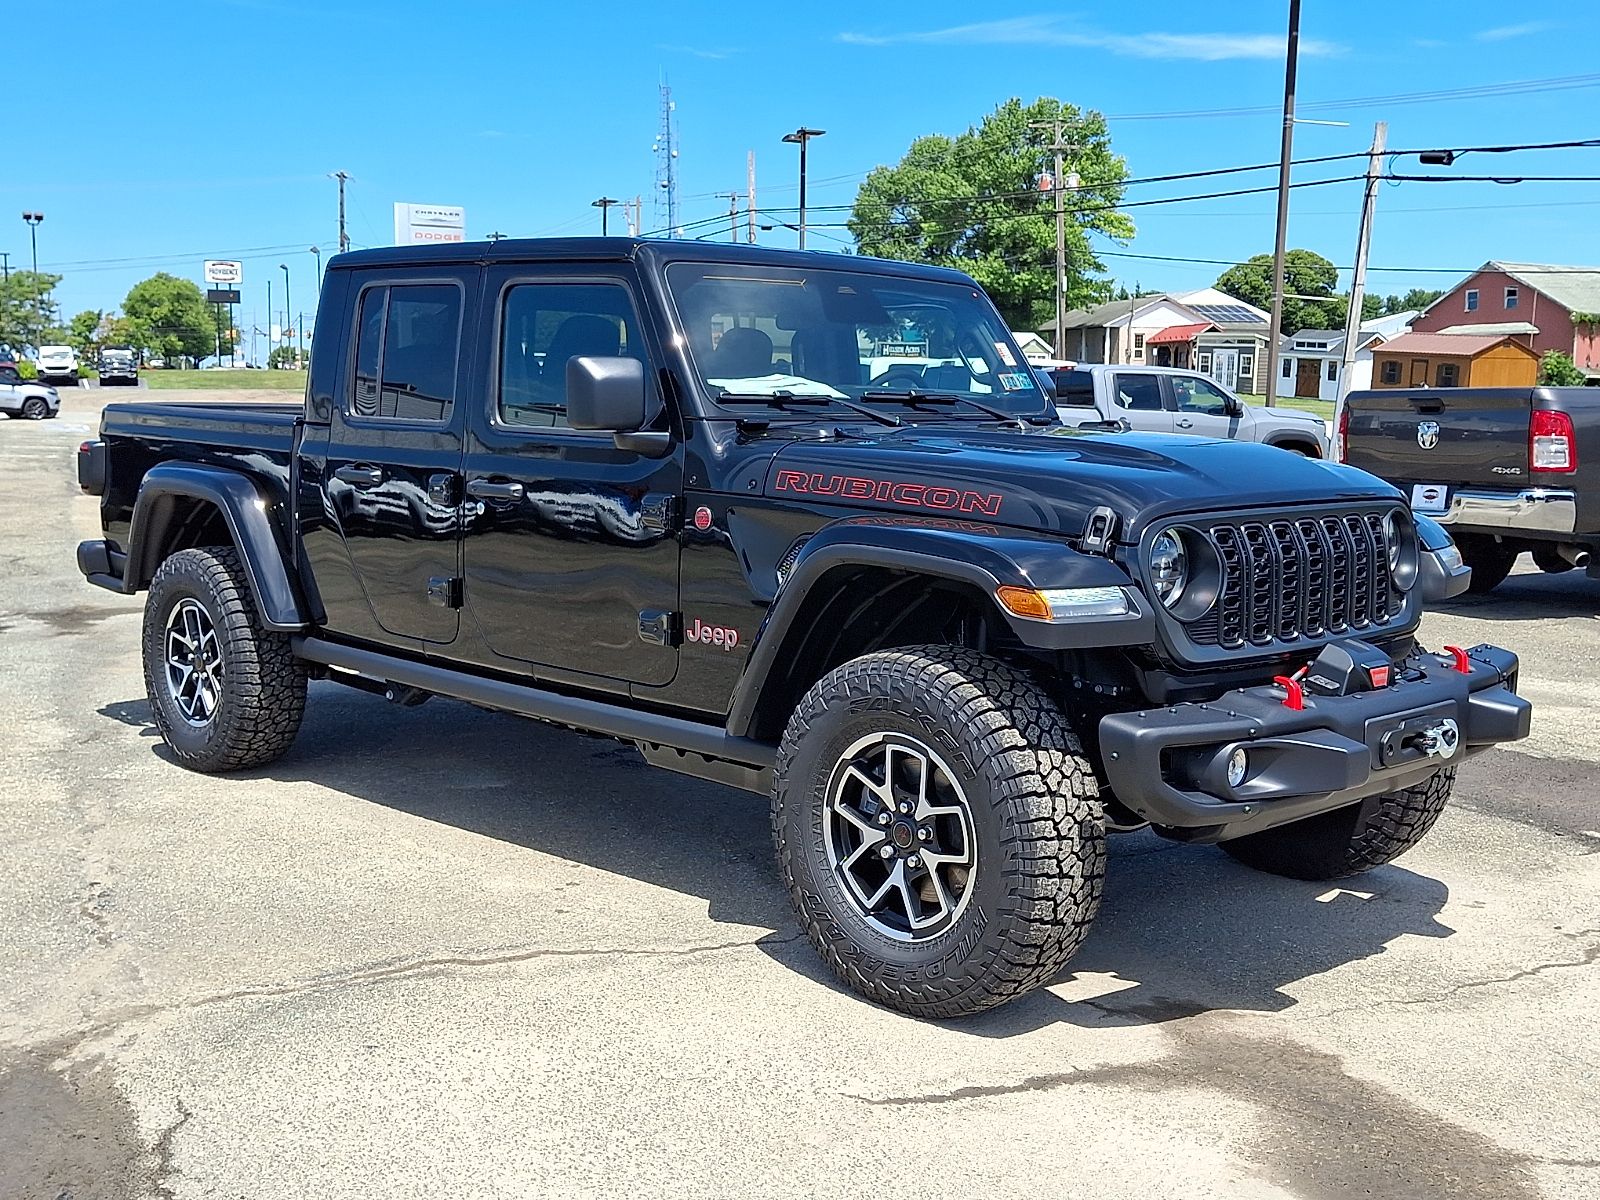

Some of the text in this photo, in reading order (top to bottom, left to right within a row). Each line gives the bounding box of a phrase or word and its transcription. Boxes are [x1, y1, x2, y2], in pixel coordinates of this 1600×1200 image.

[414, 232, 461, 241] DODGE
[775, 470, 1003, 516] RUBICON
[686, 619, 738, 651] Jeep
[844, 695, 978, 781] FALKEN
[842, 905, 989, 982] WILDPEAK
